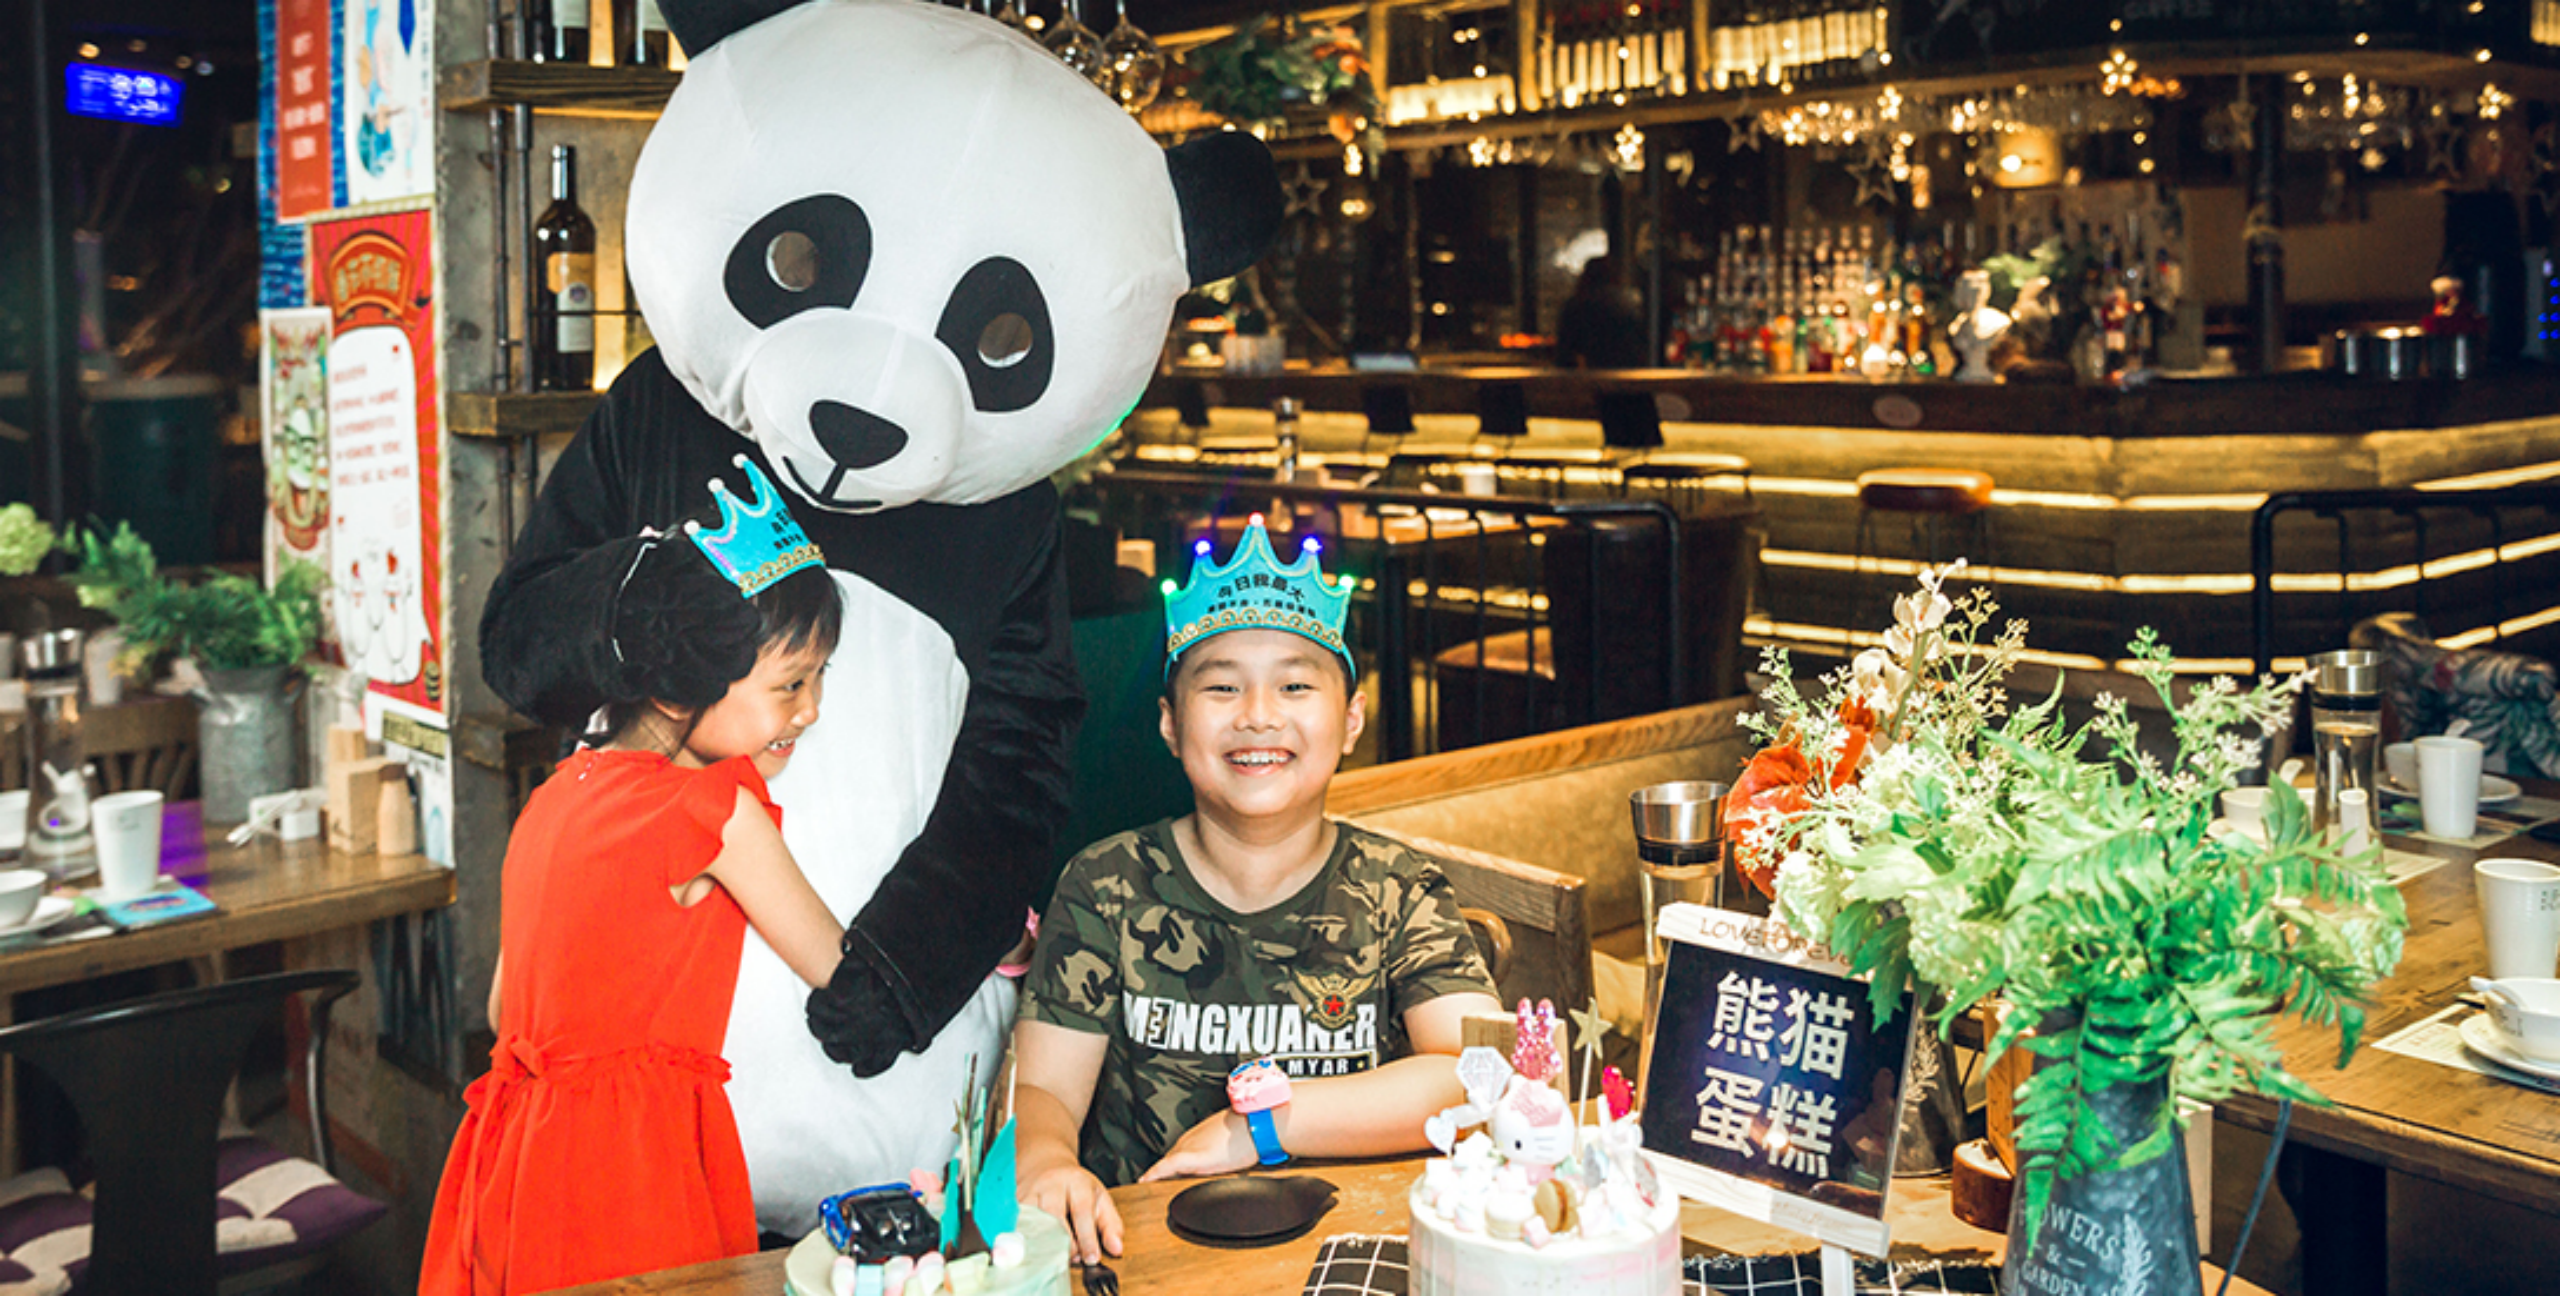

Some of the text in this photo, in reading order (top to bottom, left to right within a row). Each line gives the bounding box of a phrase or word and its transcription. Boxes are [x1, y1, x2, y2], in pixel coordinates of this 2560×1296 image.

[1288, 1058, 1349, 1076] MYAR
[1706, 970, 1855, 1081] 熊猫
[1690, 1065, 1837, 1179] 蛋糕
